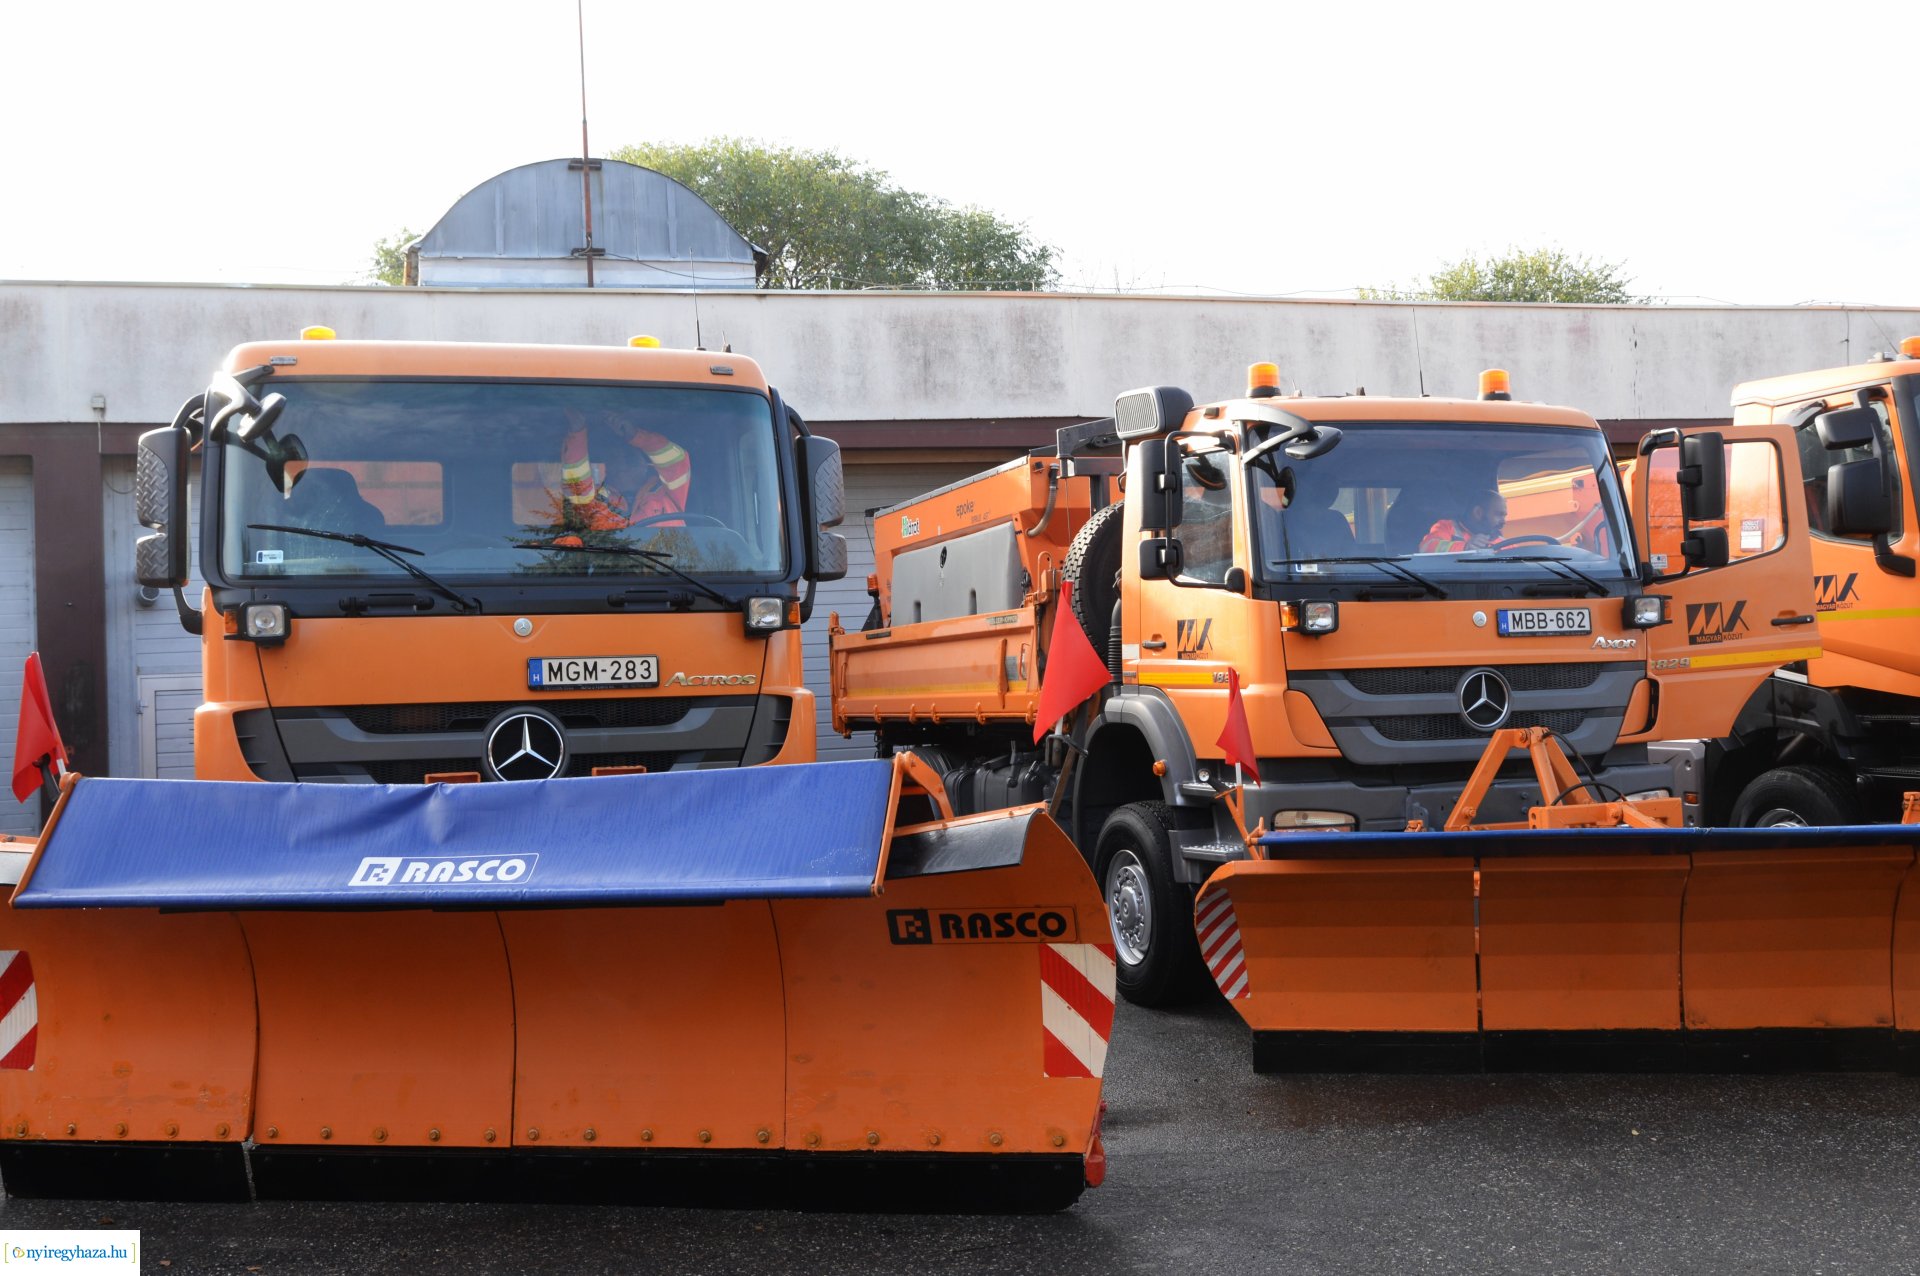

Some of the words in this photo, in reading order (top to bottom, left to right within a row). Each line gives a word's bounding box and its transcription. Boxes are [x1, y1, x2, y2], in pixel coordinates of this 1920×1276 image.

[1512, 611, 1587, 630] MBB-662
[1696, 634, 1722, 644] MAGYAR
[548, 659, 653, 683] MGM-283
[400, 858, 527, 883] RASCO
[938, 911, 1067, 939] RASCO
